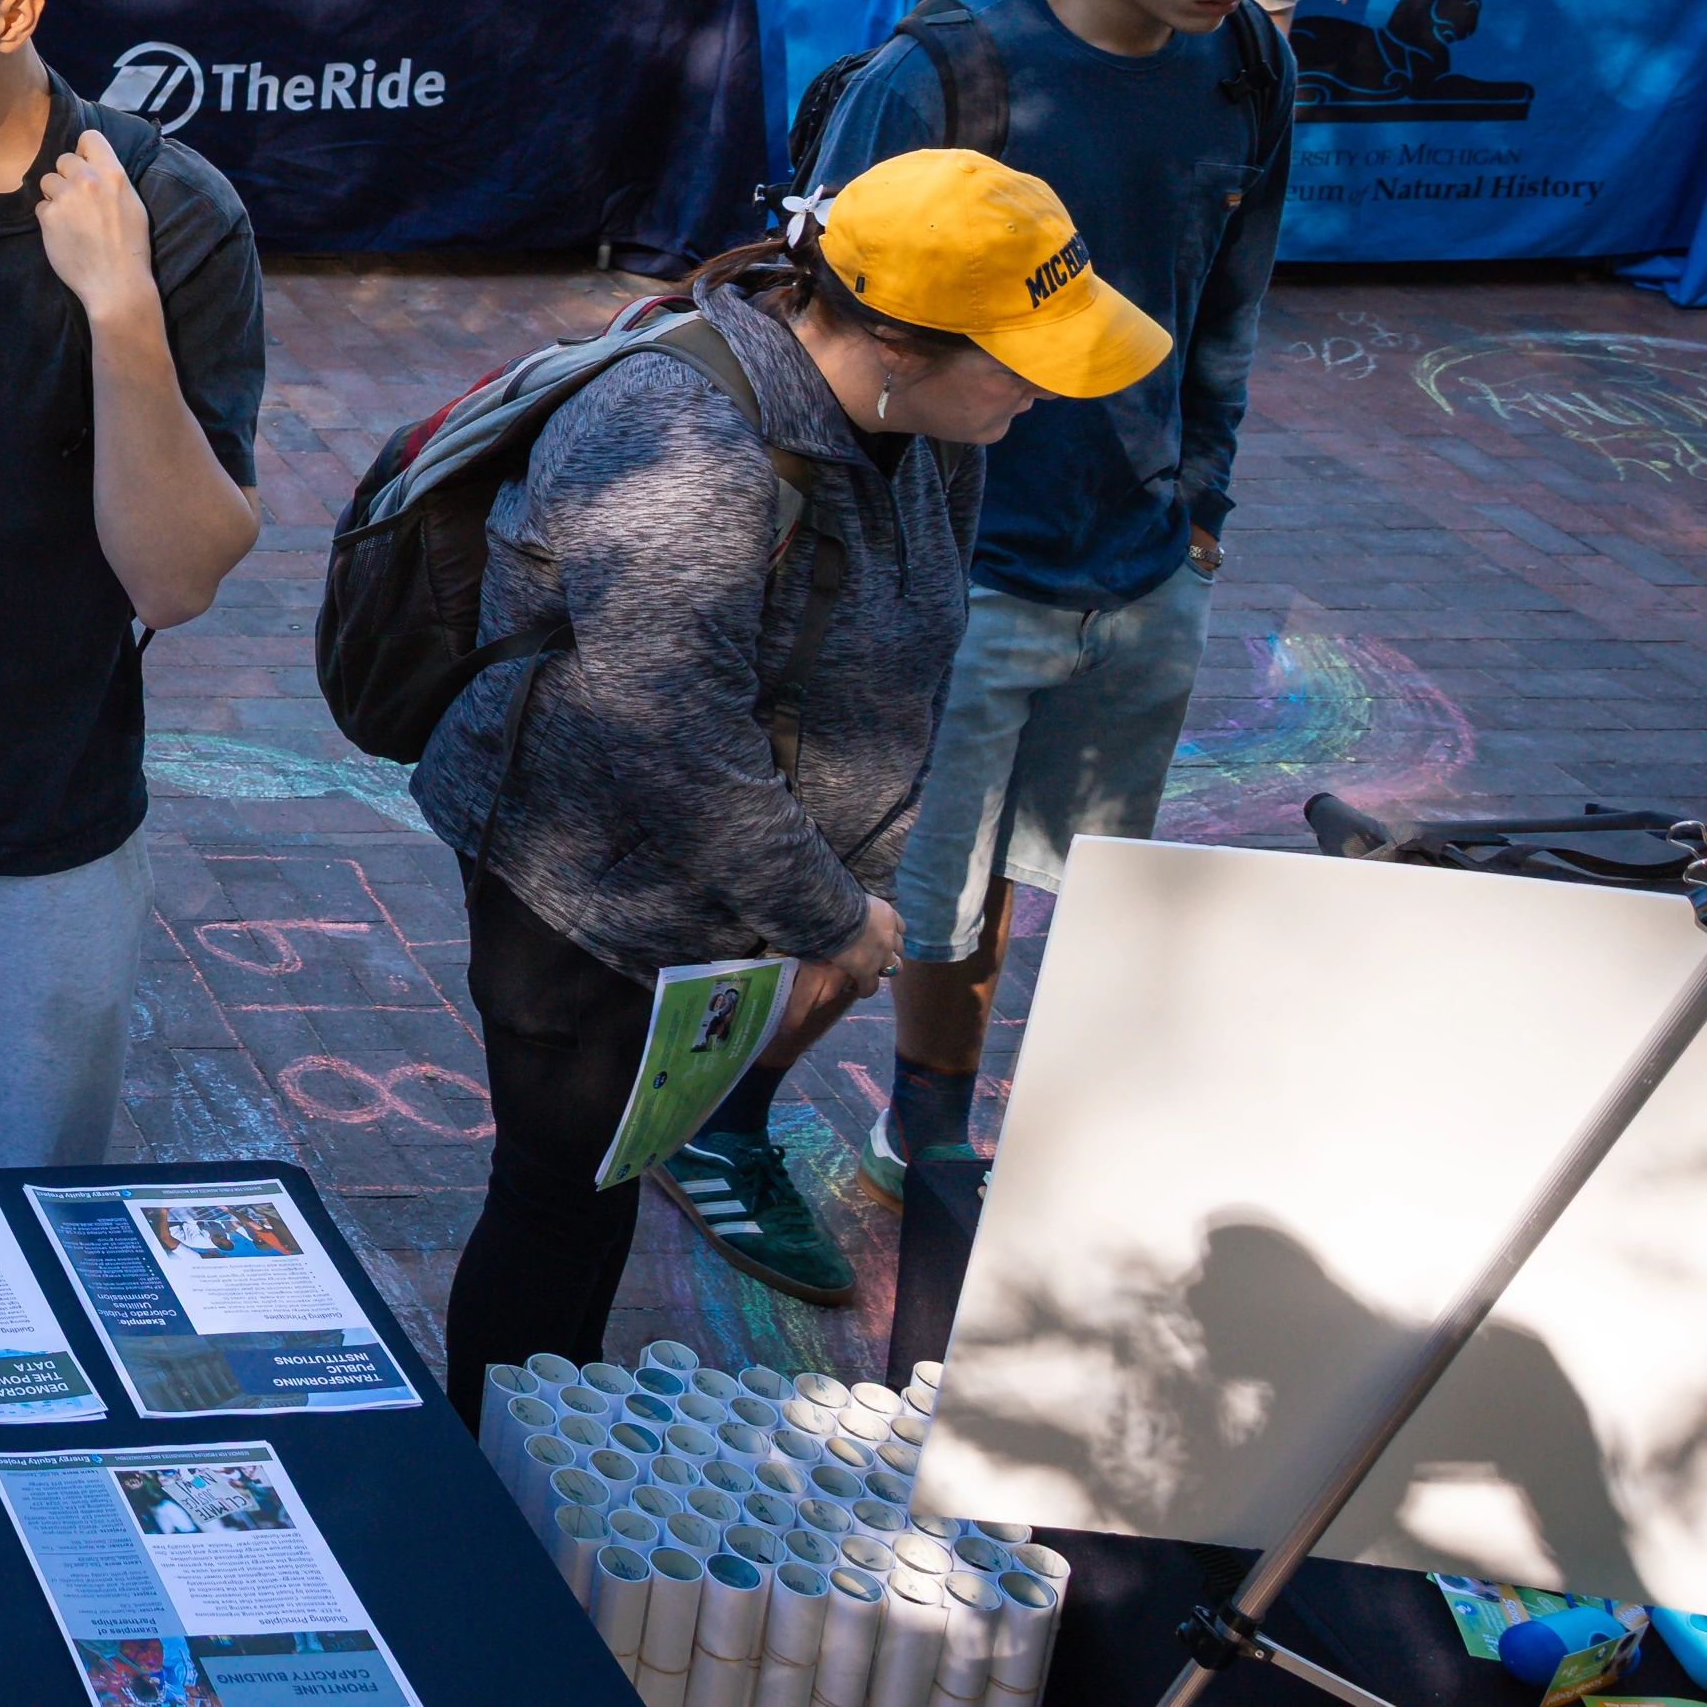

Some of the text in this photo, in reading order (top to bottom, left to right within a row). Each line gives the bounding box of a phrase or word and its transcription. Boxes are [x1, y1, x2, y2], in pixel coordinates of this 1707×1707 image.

[211, 58, 446, 111] TheRide
[1287, 185, 1344, 204] eum
[1372, 175, 1484, 202] Natural
[1487, 175, 1607, 206] History
[65, 1191, 90, 1200] Equity
[91, 1189, 121, 1199] Energy
[97, 1293, 159, 1302] Commission
[113, 1301, 152, 1310] Utilities
[98, 1308, 178, 1319] Colorado Public
[117, 1317, 166, 1327] Example:
[0, 1325, 35, 1335] Guiding
[273, 1353, 370, 1365] INSTITUTIONS
[12, 1360, 56, 1373] DATA
[326, 1362, 376, 1374] PUBLIC
[37, 1371, 63, 1385] THE
[272, 1373, 384, 1387] TRANSFORMING
[28, 1456, 53, 1466] Equity
[53, 1455, 91, 1466] Energy
[194, 1495, 248, 1522] CLIMATE
[90, 1617, 156, 1627] Partnerships
[258, 1614, 348, 1626] Guiding Principles
[109, 1626, 159, 1635] Examples
[215, 1669, 371, 1684] CAPACITY BUILDING
[292, 1681, 379, 1696] FRONTLINE
